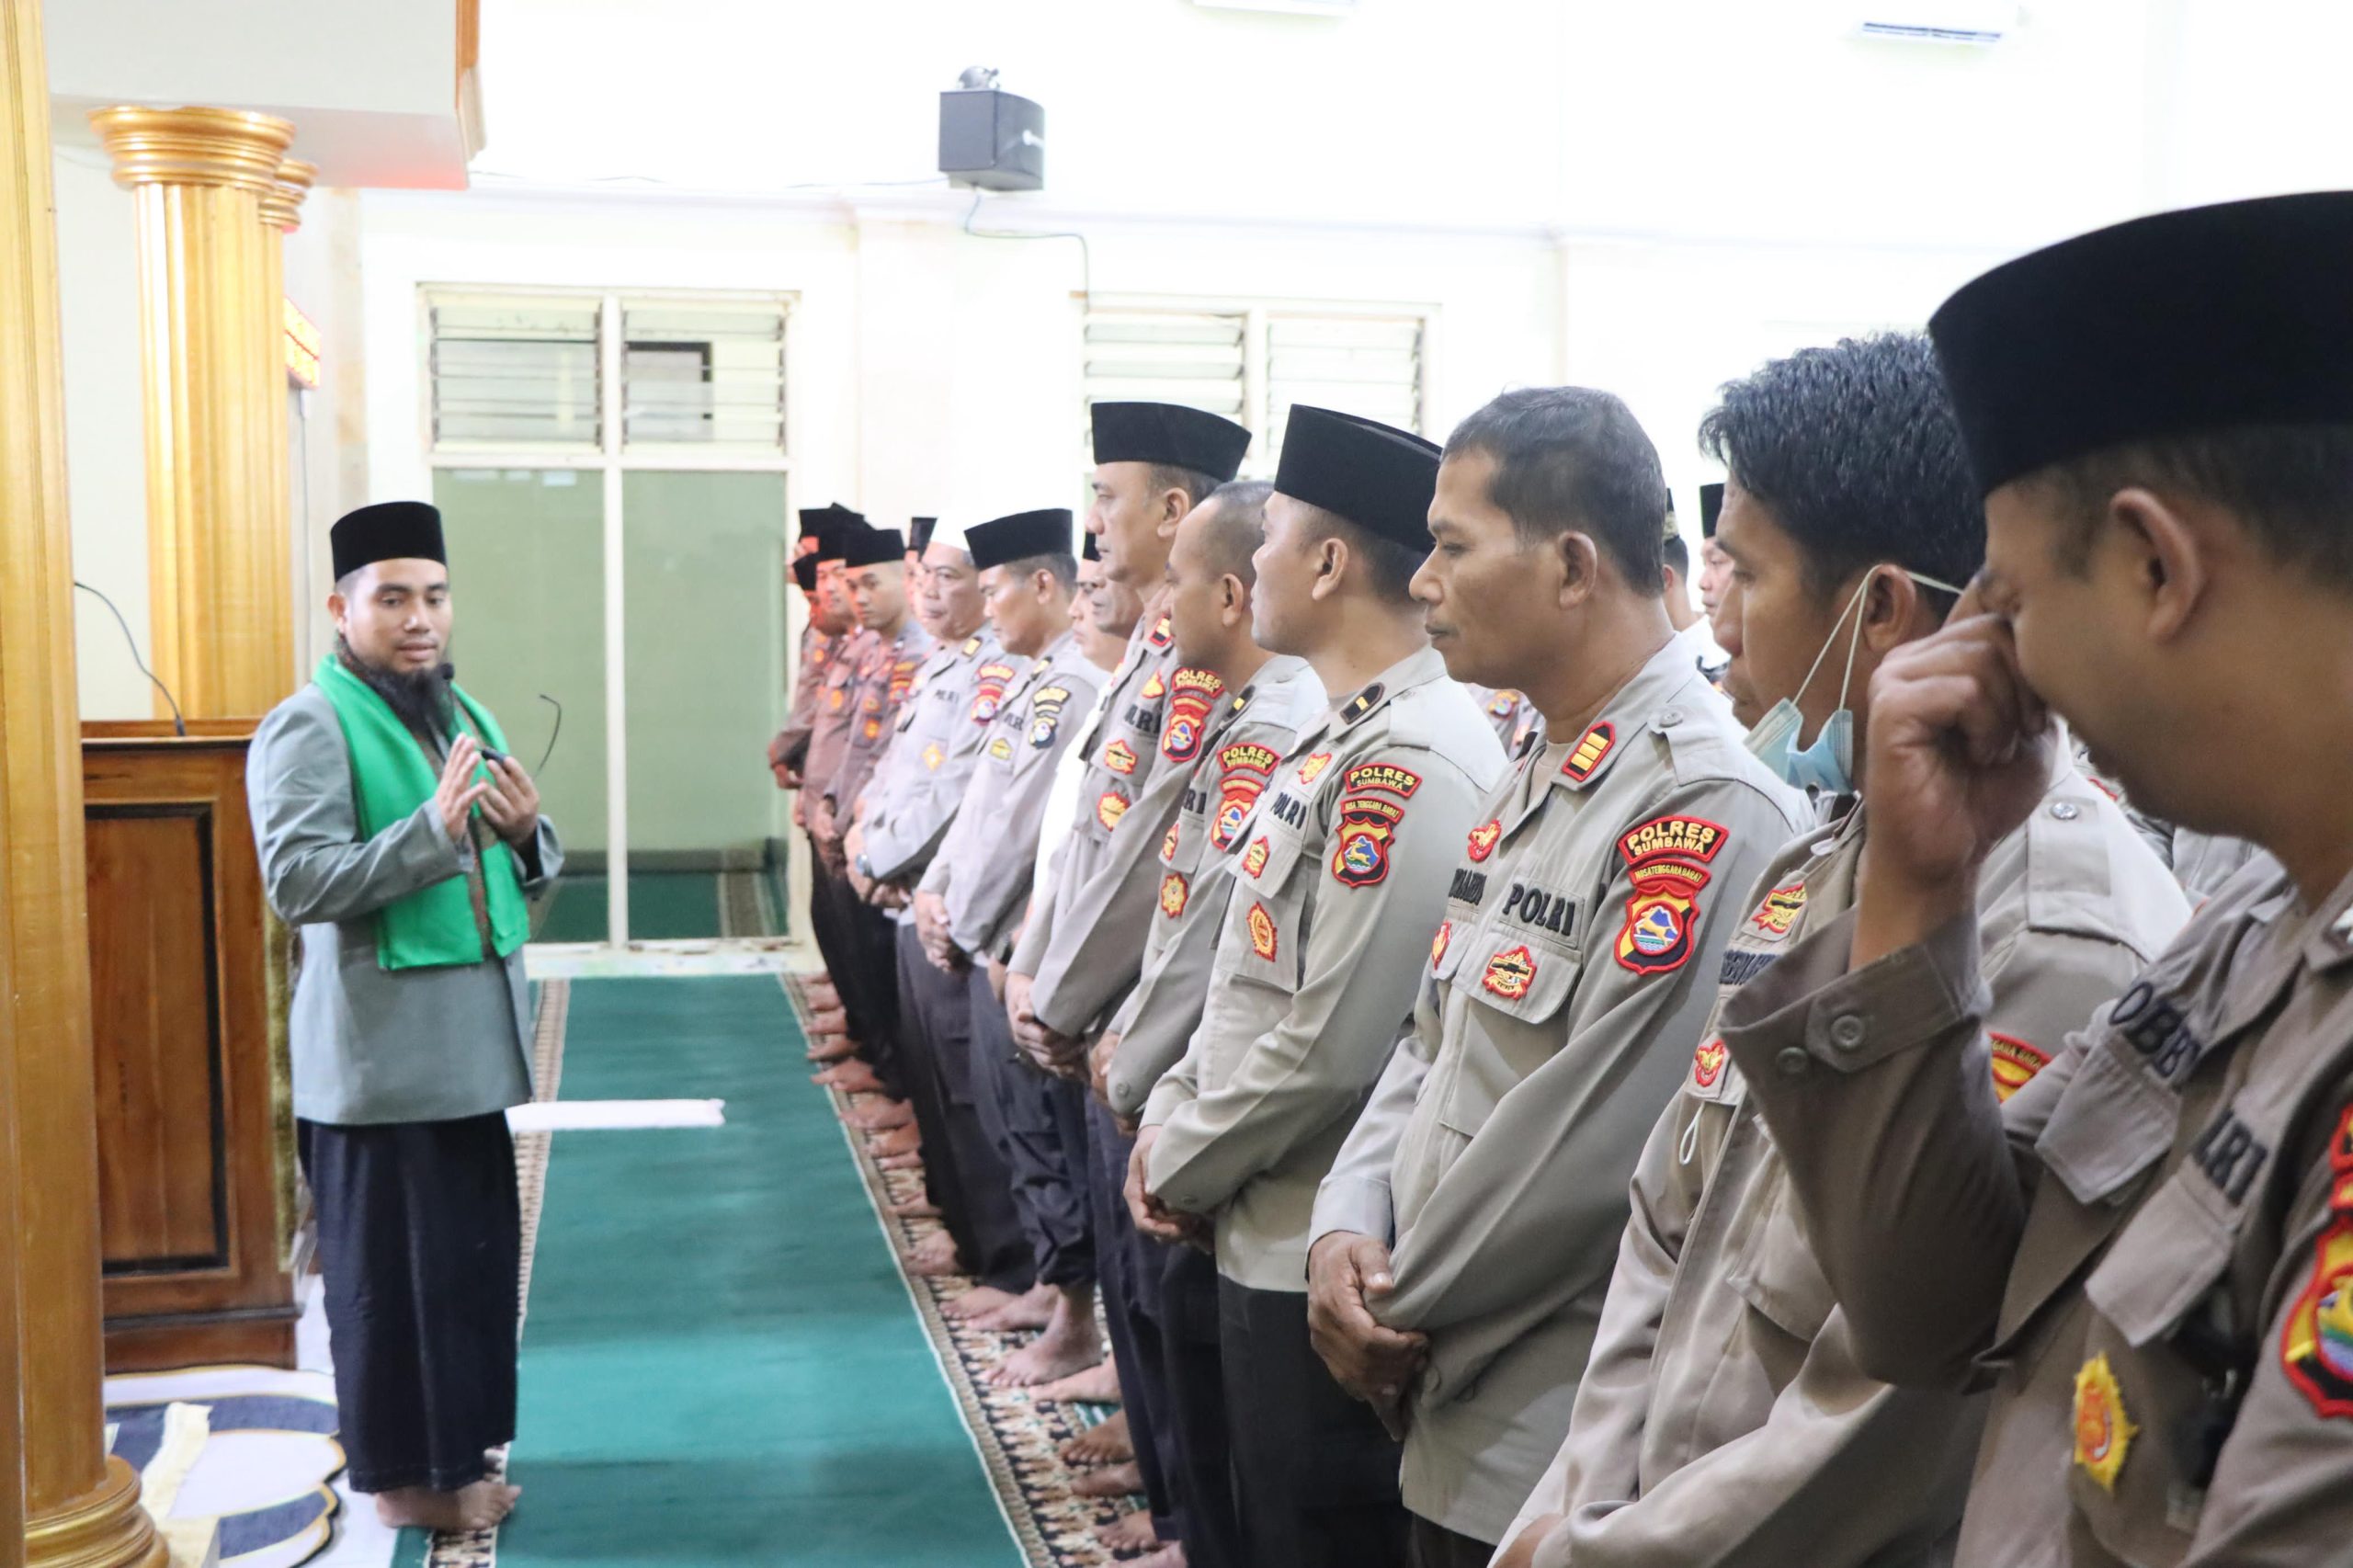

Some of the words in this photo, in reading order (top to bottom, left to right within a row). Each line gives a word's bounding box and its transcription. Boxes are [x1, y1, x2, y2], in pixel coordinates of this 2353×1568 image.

[1223, 746, 1275, 765] POLRES
[1349, 767, 1415, 787] POLRES
[1357, 777, 1404, 790] SUMBAWA
[1627, 820, 1715, 851] POLRES
[1634, 835, 1704, 857] SUMBAWA
[1502, 883, 1575, 937] POLRI
